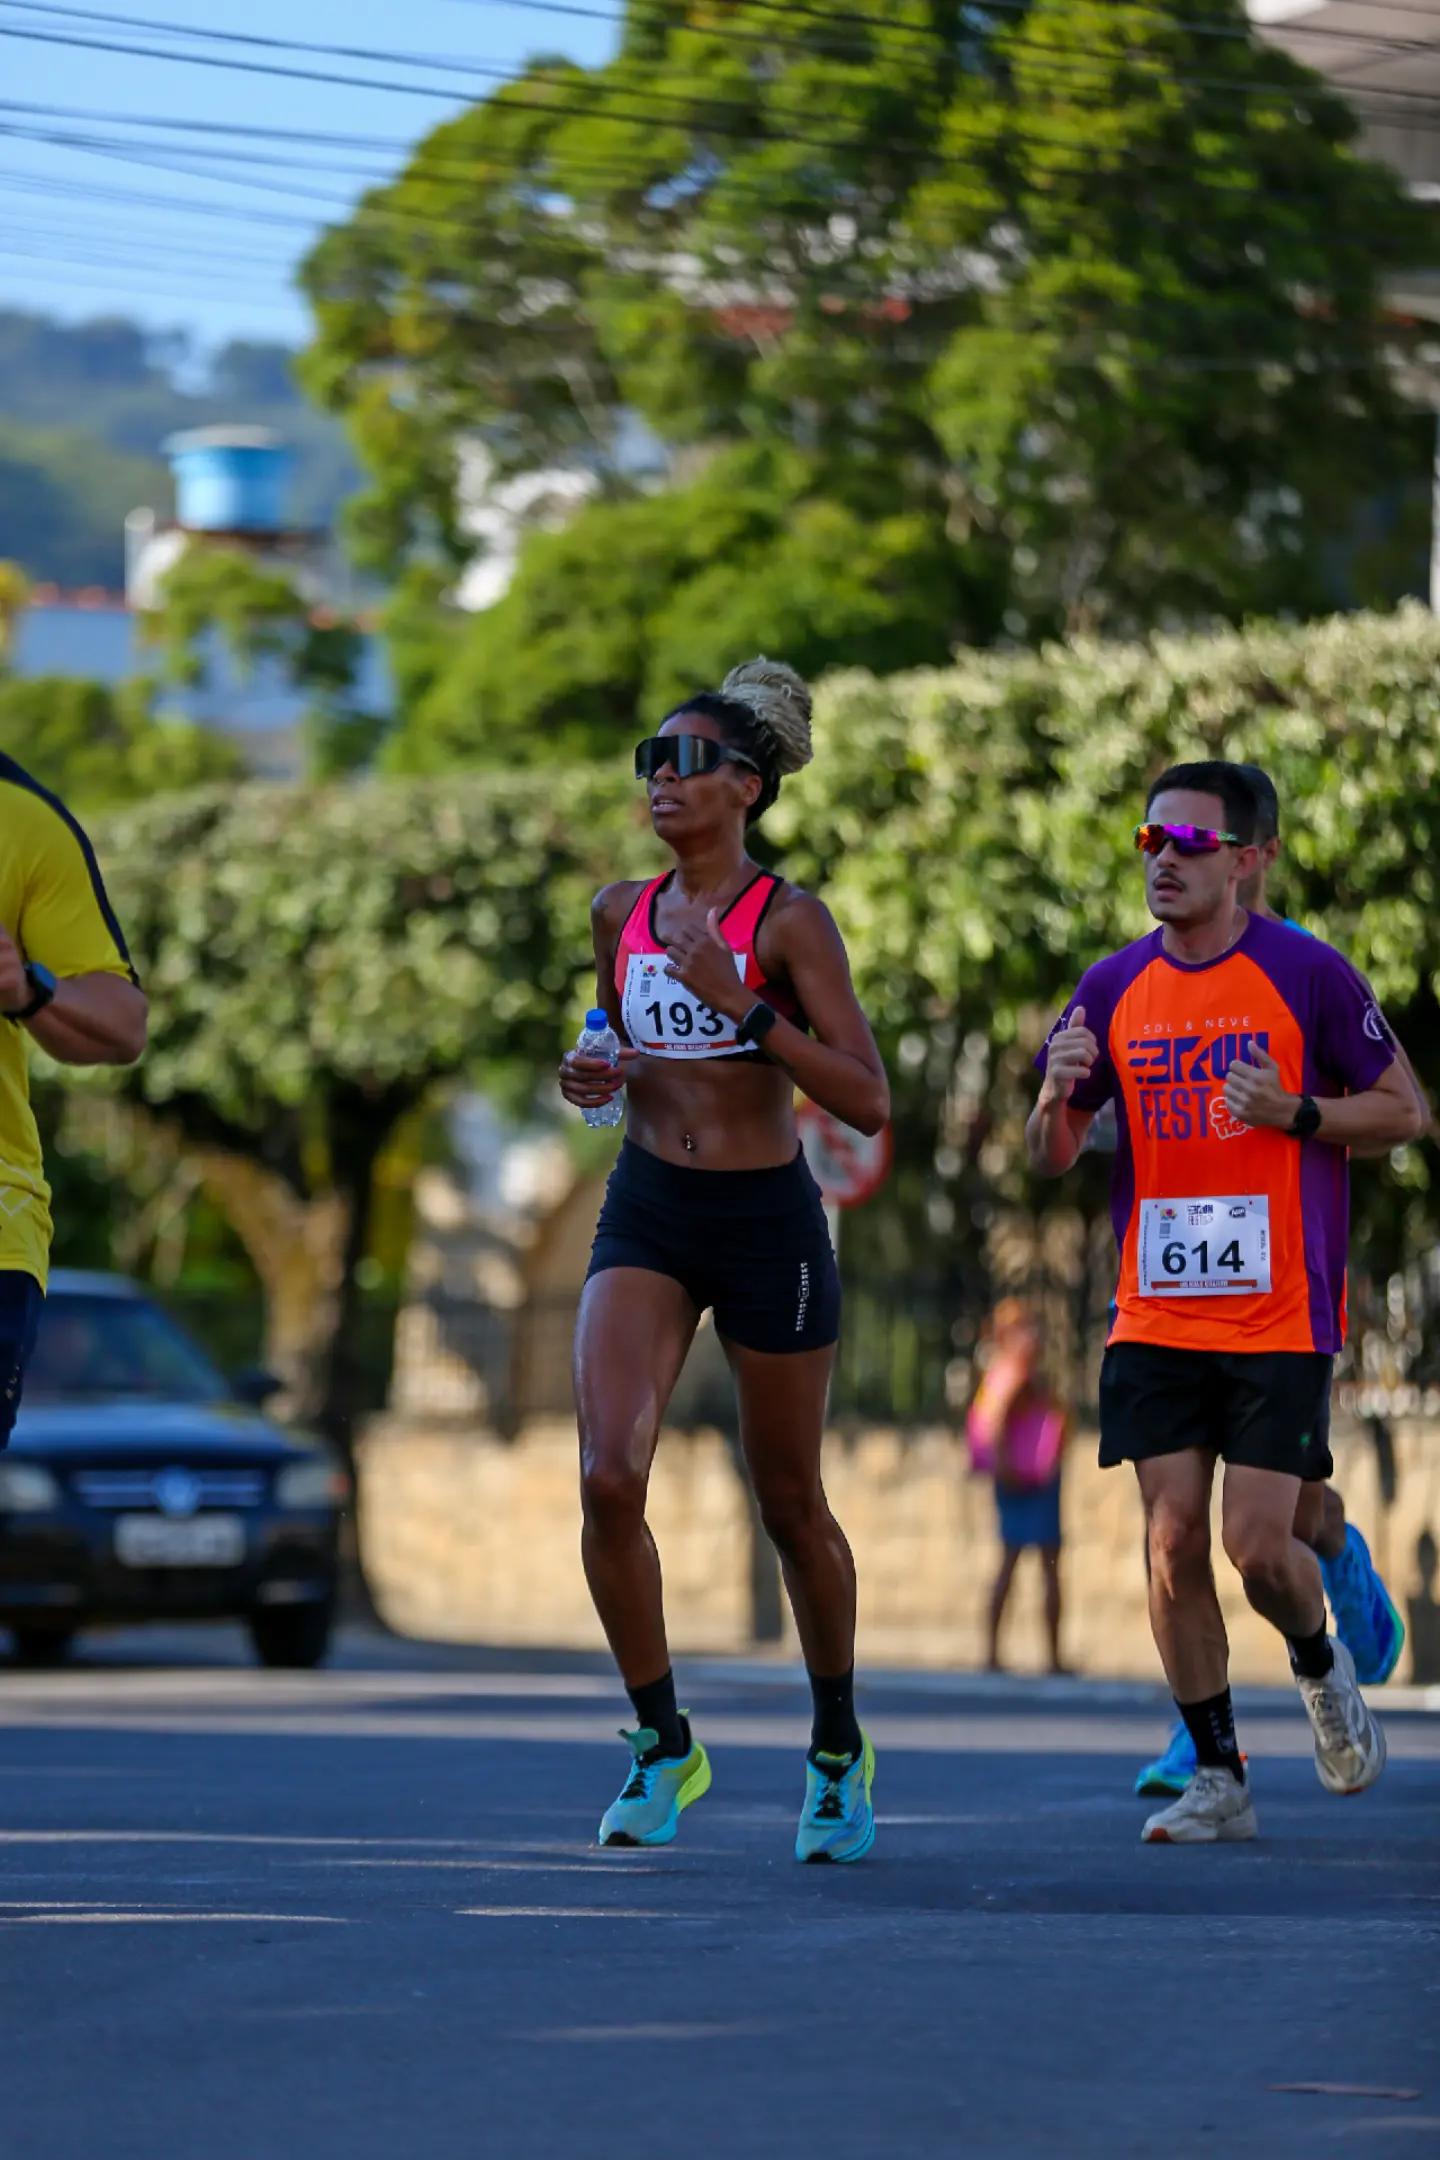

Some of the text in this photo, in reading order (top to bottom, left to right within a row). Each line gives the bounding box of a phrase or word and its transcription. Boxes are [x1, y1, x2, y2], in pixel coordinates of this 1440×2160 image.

[645, 1001, 724, 1036] 193
[1185, 1020, 1194, 1031] &
[1205, 1015, 1250, 1028] NEVE
[1139, 1087, 1211, 1140] FEST
[1162, 1240, 1245, 1275] 614
